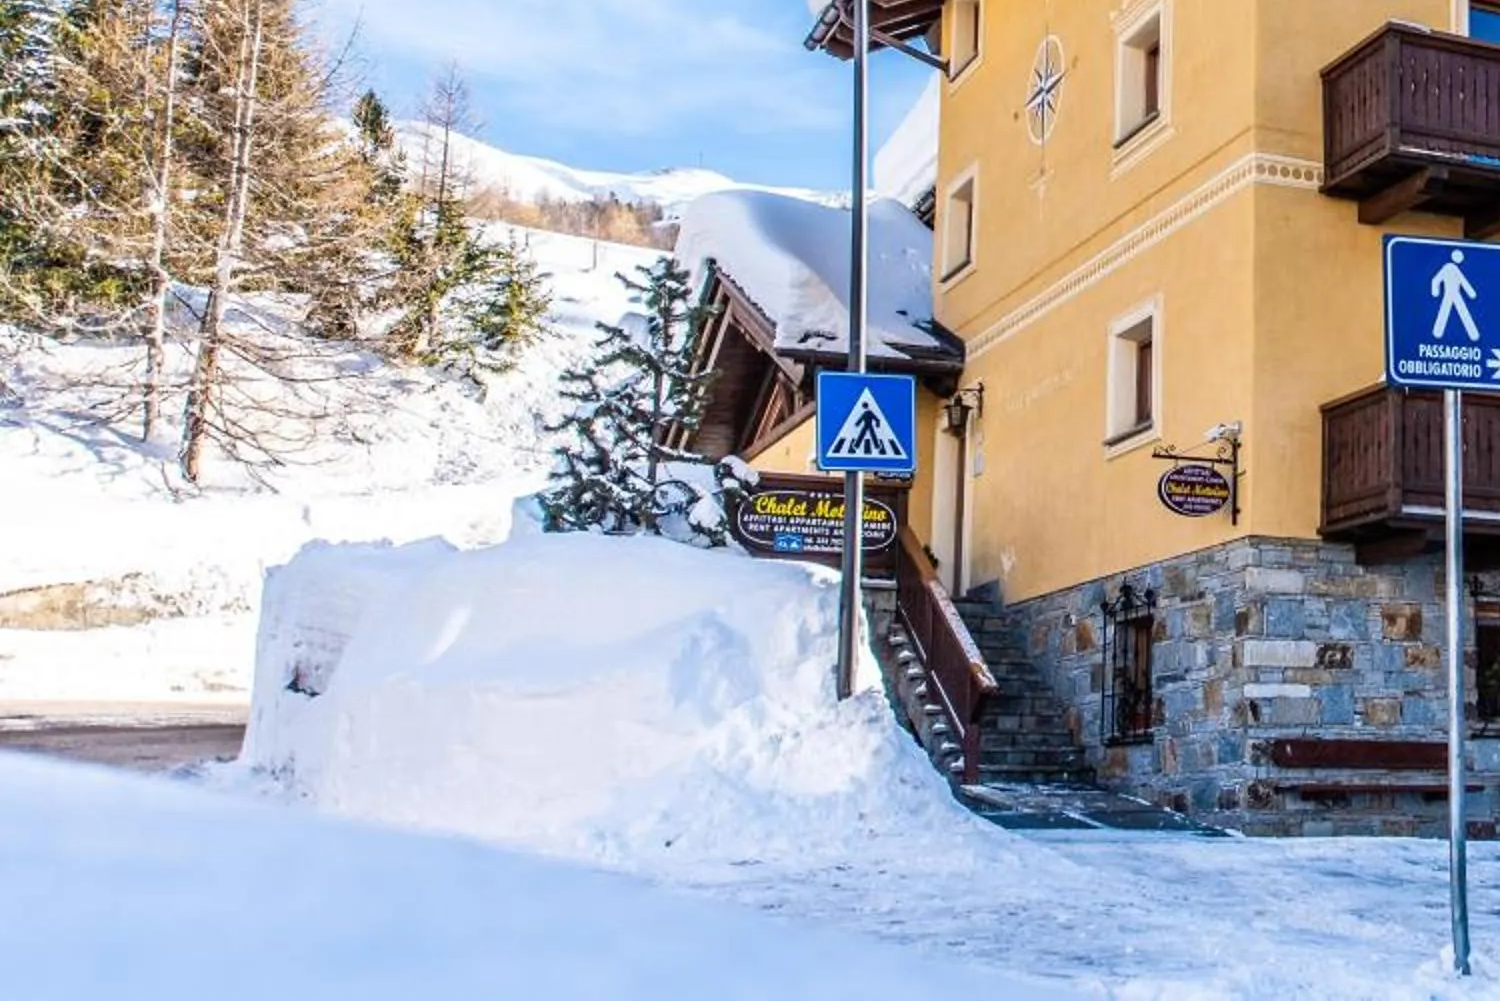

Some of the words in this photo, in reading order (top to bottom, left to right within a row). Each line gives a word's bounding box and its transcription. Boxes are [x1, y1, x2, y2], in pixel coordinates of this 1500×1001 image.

[1419, 343, 1482, 362] PASSAGGIO
[1398, 359, 1482, 378] OBBLIGATORIO
[755, 496, 807, 517] Chalet
